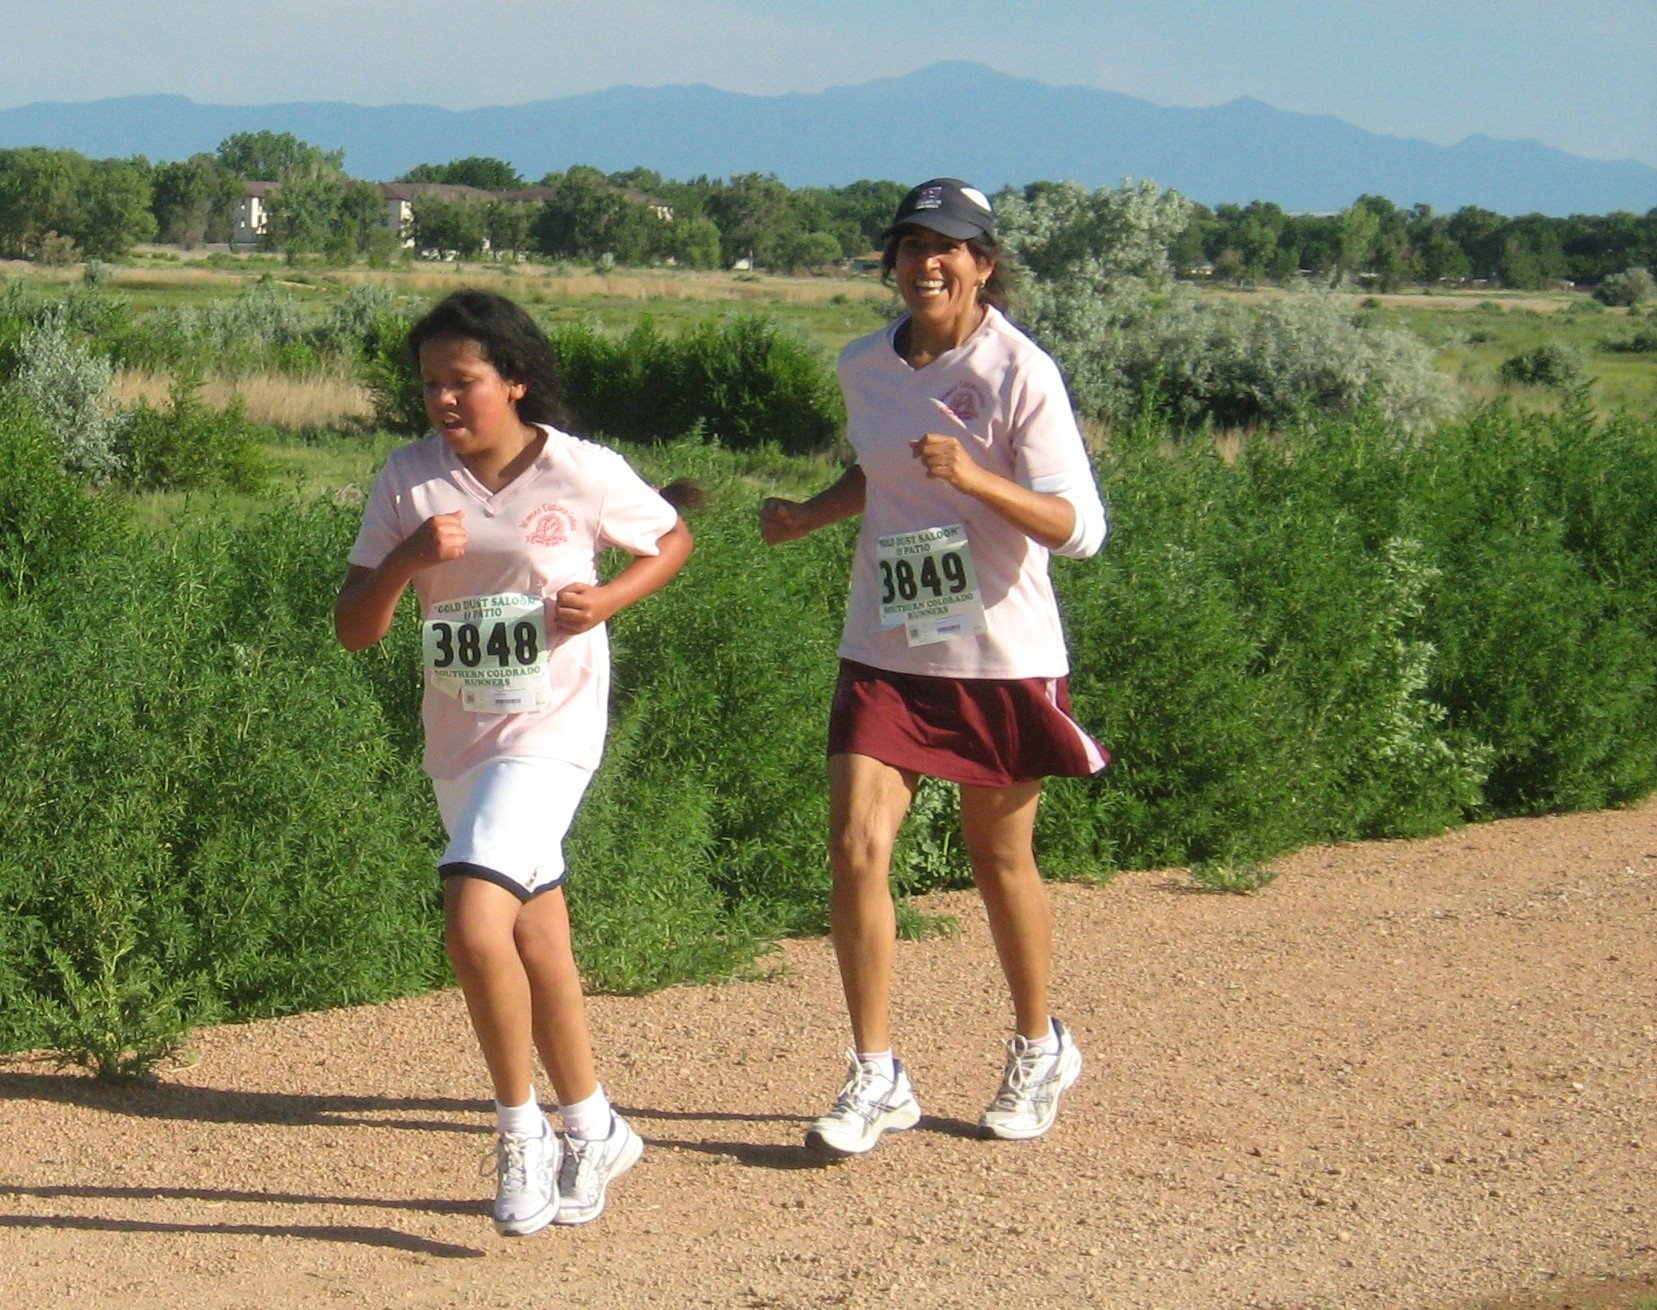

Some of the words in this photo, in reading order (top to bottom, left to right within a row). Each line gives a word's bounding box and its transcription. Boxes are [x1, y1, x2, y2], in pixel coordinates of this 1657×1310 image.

[879, 552, 967, 603] 3849
[463, 598, 489, 610] DUST
[491, 596, 534, 607] SALOON
[474, 607, 503, 619] PATIO
[432, 622, 538, 667] 3848
[487, 666, 540, 678] COLORADO
